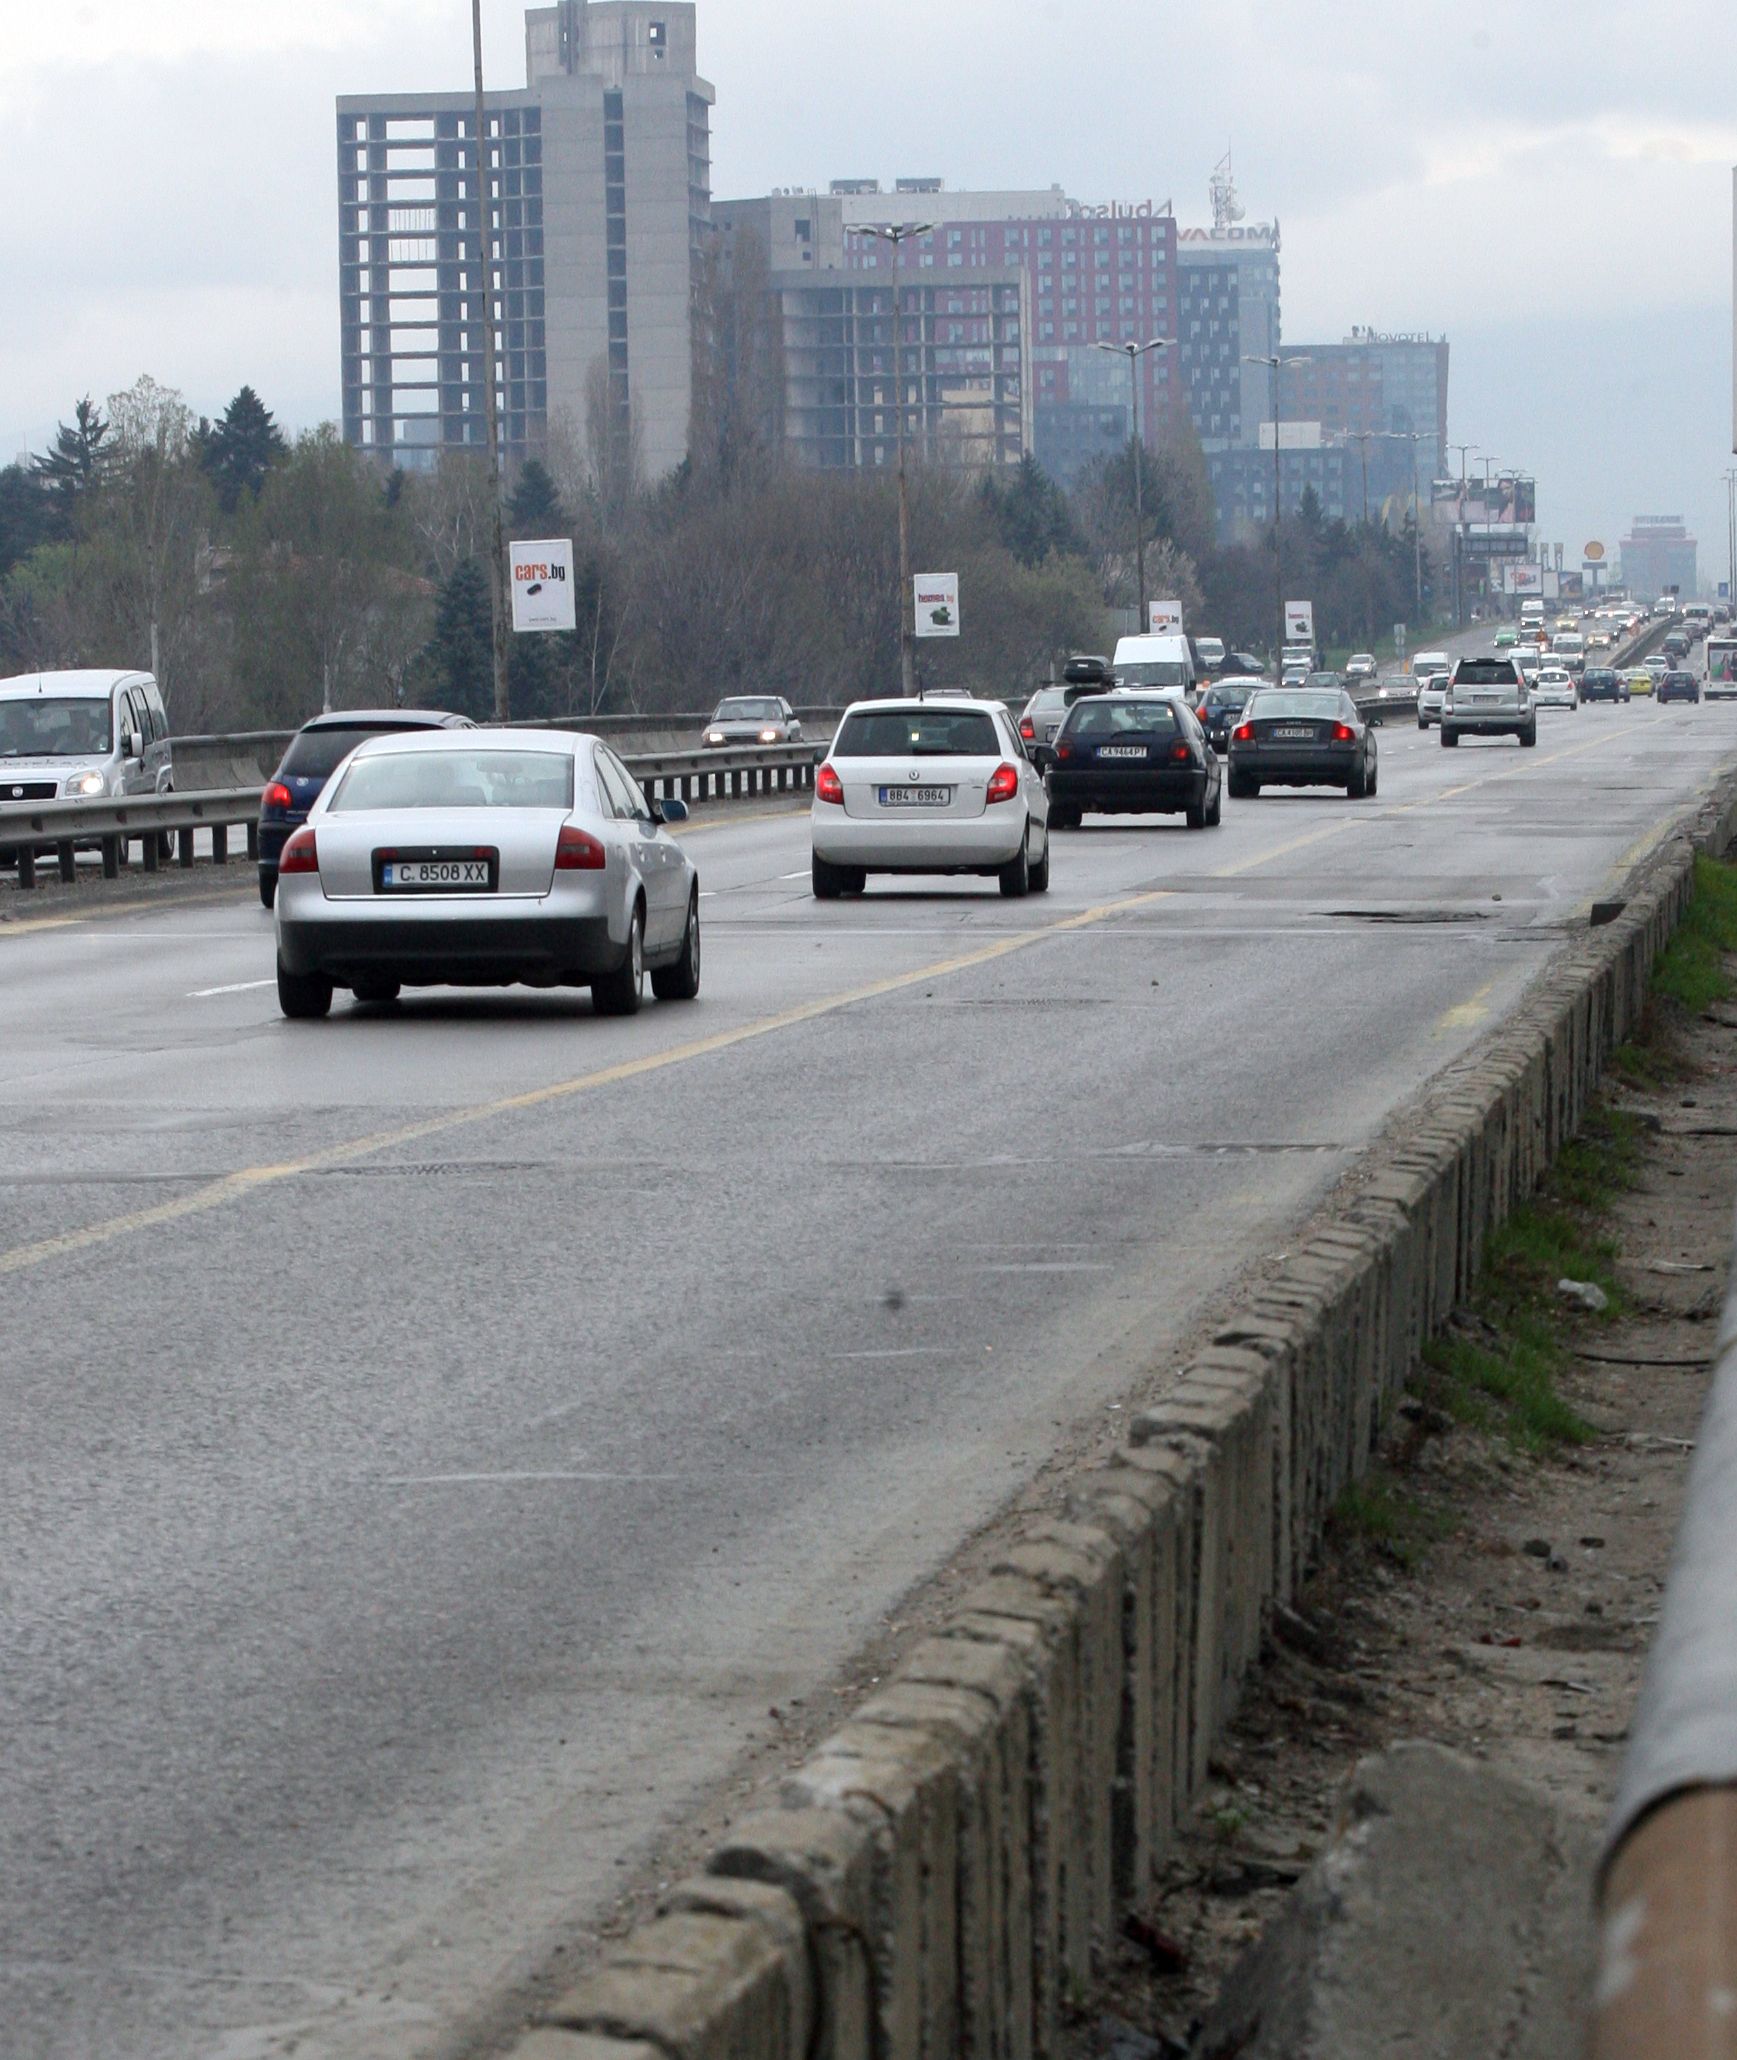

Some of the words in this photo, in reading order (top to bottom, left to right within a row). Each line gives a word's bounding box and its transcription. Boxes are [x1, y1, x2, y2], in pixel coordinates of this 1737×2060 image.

[515, 563, 566, 581] cars.bg
[419, 864, 460, 881] 8508
[463, 864, 485, 881] XX
